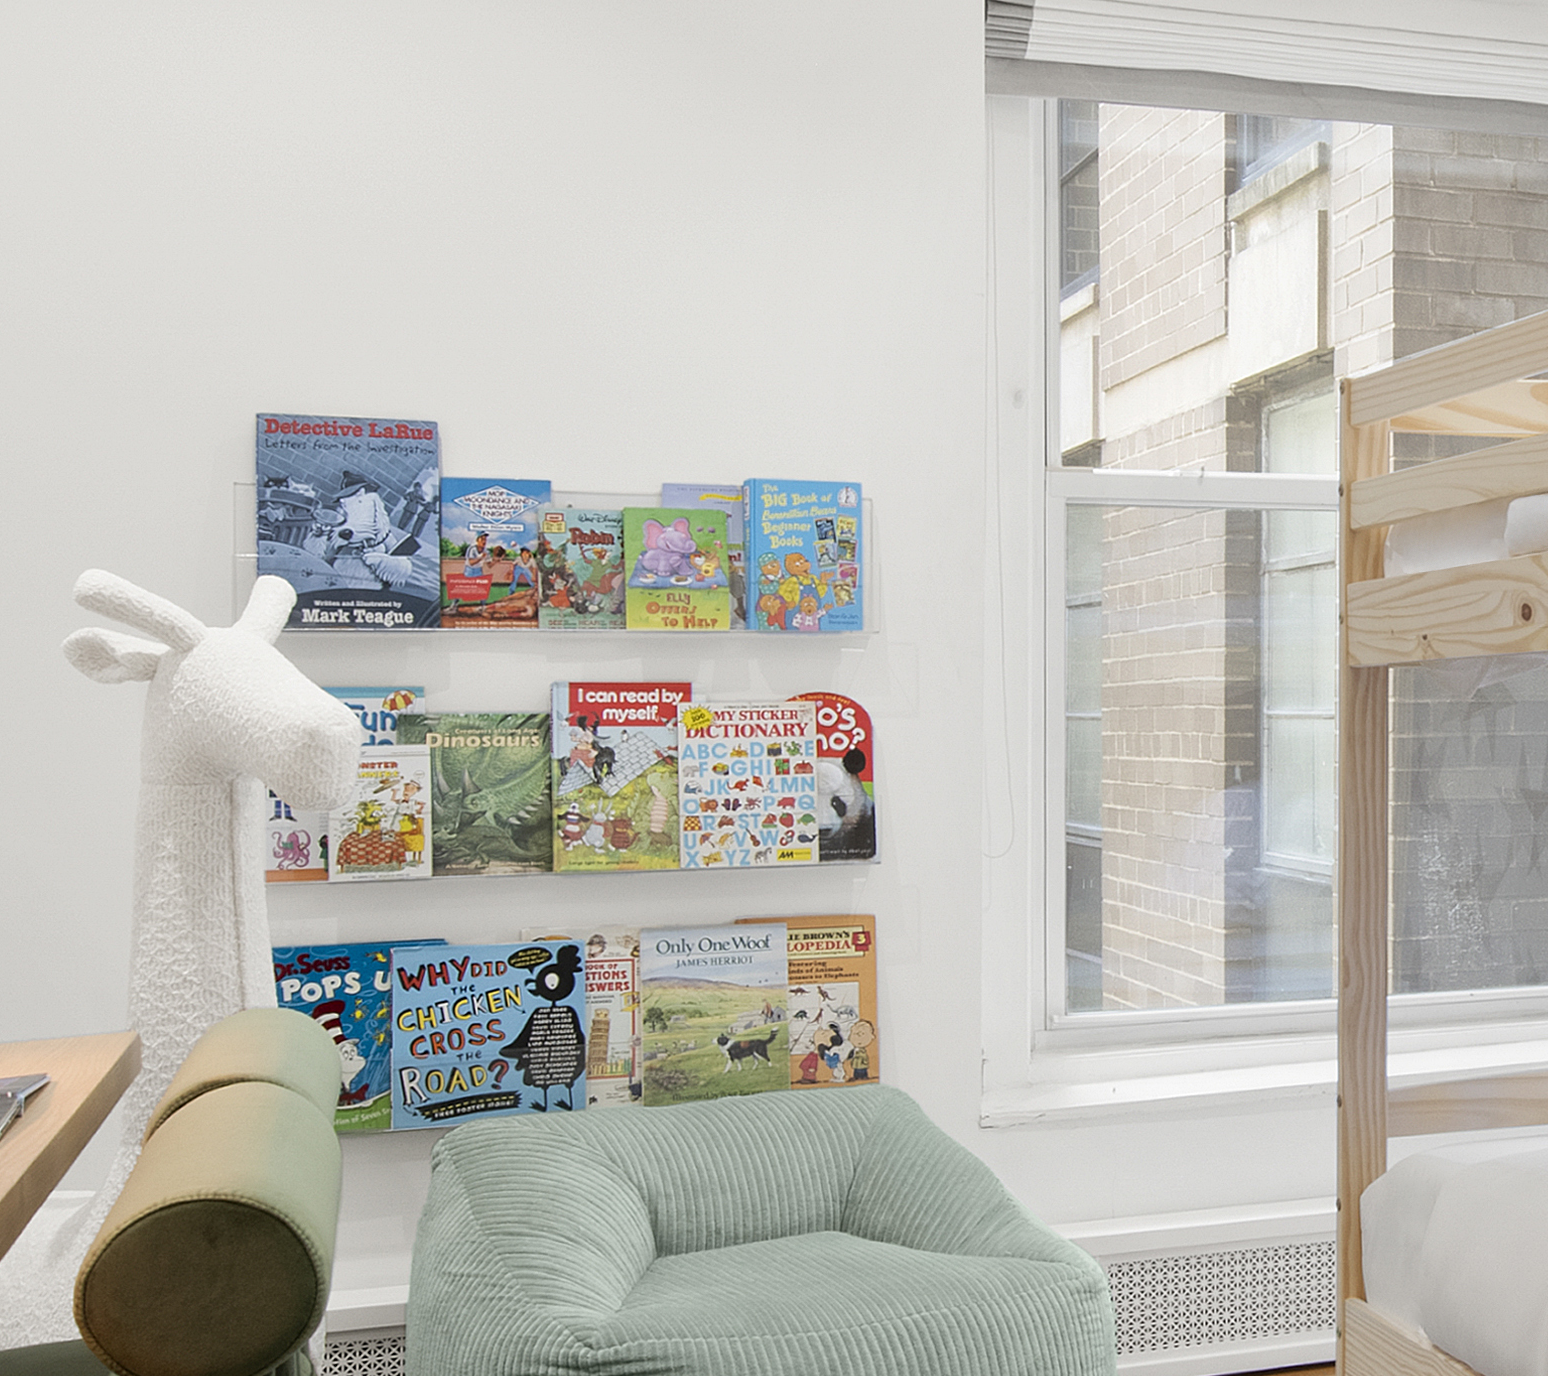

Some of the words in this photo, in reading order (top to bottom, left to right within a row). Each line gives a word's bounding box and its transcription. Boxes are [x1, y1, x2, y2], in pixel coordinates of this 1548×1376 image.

[264, 418, 363, 437] Detective
[368, 422, 434, 440] LaRue
[265, 438, 307, 450] Letters
[312, 439, 338, 451] from
[342, 442, 360, 452] the
[367, 443, 435, 456] Investigation
[761, 494, 788, 508] BIG
[792, 493, 817, 505] Book
[821, 494, 831, 503] of
[569, 526, 615, 545] Robin
[762, 522, 811, 536] Beginner
[770, 535, 804, 549] Books
[666, 592, 691, 604] ELLY
[302, 609, 350, 623] Mark
[353, 609, 415, 627] Teague
[662, 616, 678, 627] TO
[682, 614, 719, 629] HELP
[578, 688, 583, 703] I
[585, 691, 617, 703] can
[619, 688, 660, 703] read
[661, 688, 684, 706] by
[602, 705, 659, 723] myself
[713, 710, 736, 722] MY
[739, 709, 798, 721] STICKER
[686, 722, 810, 739] DICTIONARY
[426, 732, 540, 748] Dinosaurs
[803, 930, 850, 941] BROWN'S
[856, 933, 866, 944] 3
[656, 937, 694, 956] Only
[698, 937, 730, 952] One
[731, 933, 772, 950] Woof
[787, 939, 851, 953] LOPEDIA
[296, 953, 350, 974] Seuss
[675, 957, 708, 969] JAMES
[711, 955, 753, 966] HERRIOT
[397, 956, 470, 991] WHY
[471, 960, 508, 978] DID
[586, 970, 627, 981] STIONS
[281, 971, 362, 1002] POPS
[452, 984, 476, 995] THE
[397, 985, 523, 1032] CHICKEN
[410, 1019, 506, 1059] CROSS
[456, 1050, 483, 1062] THE
[399, 1059, 510, 1107] ROAD?
